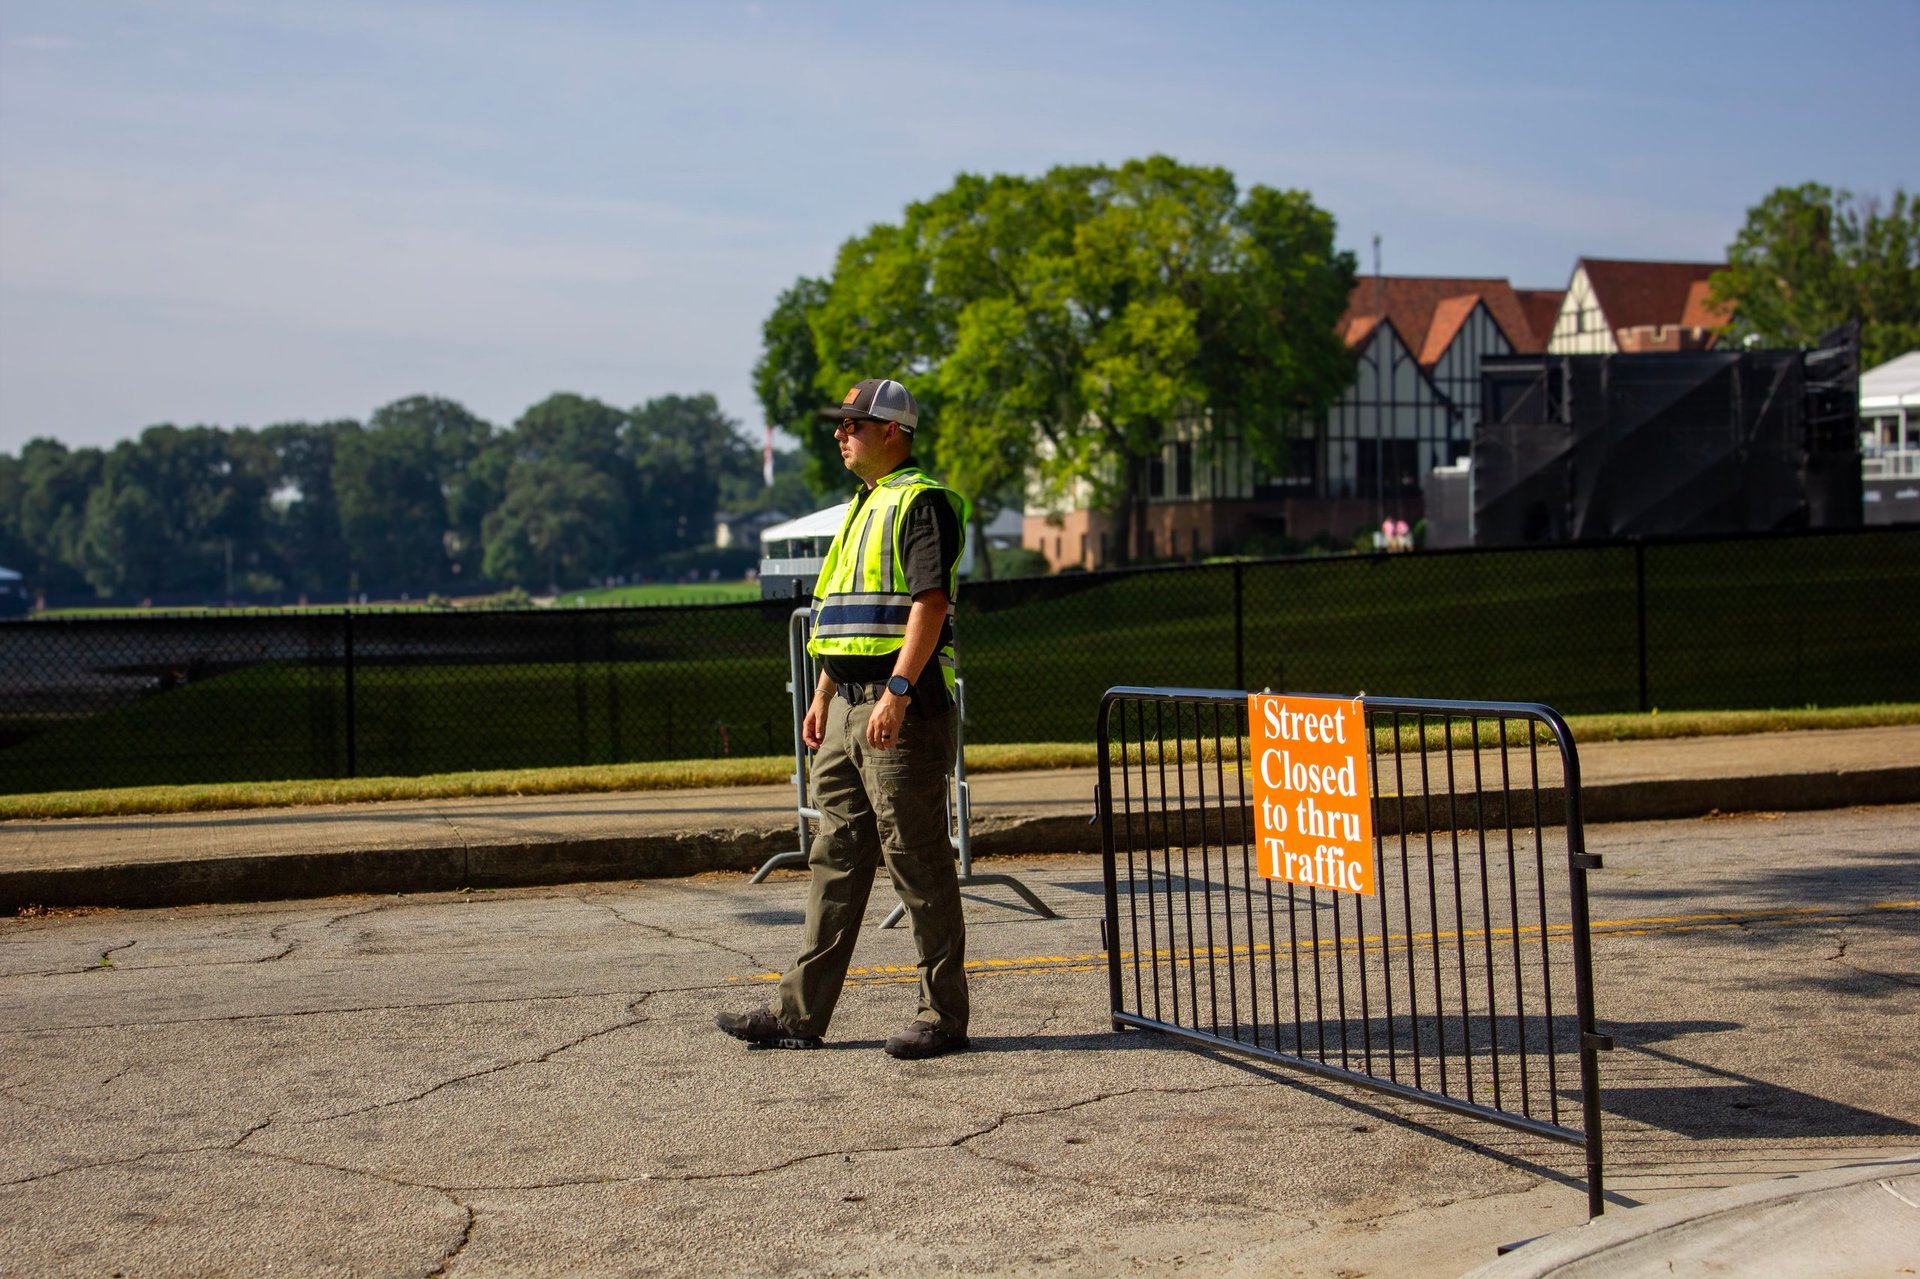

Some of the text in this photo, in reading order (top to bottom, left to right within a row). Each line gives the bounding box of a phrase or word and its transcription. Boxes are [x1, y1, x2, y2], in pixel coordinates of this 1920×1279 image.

[1264, 699, 1346, 744] Street
[1261, 748, 1357, 797] Closed
[1262, 795, 1362, 842] to thru
[1264, 838, 1364, 891] Traffic
